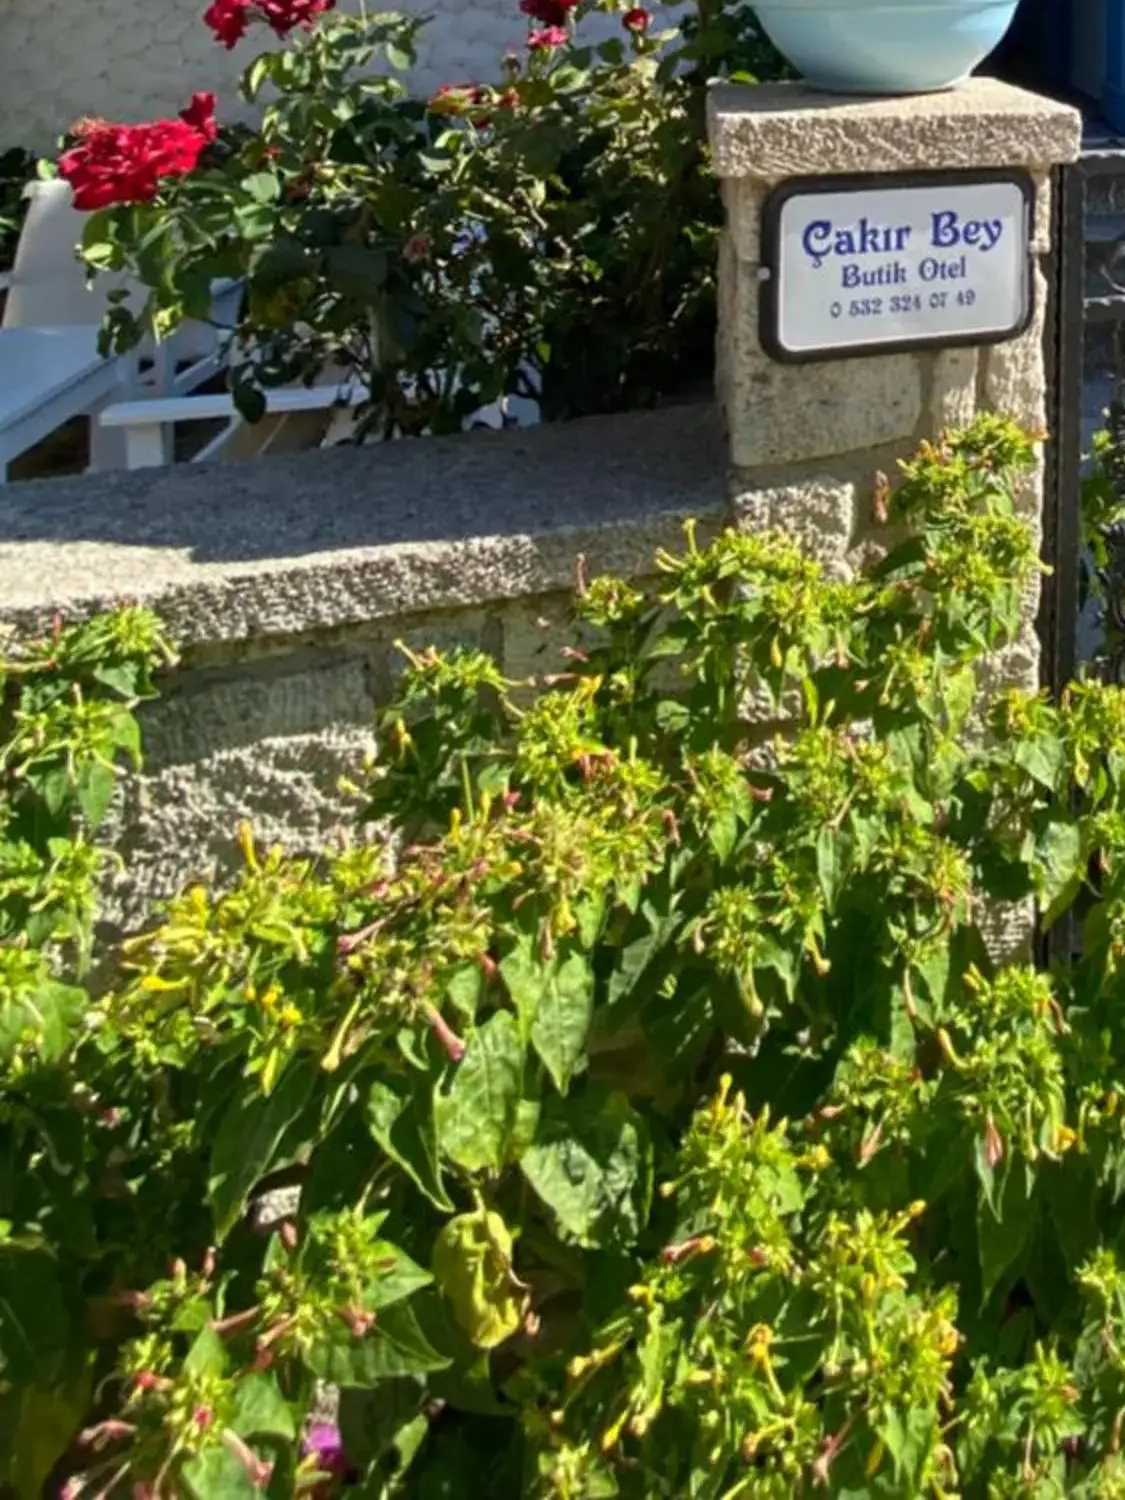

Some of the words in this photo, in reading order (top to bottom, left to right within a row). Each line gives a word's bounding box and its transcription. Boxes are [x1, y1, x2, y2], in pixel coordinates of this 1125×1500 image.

[801, 217, 912, 268] Çakır
[930, 210, 1004, 252] Bey
[841, 260, 908, 289] Butik
[918, 255, 967, 282] Otel
[829, 300, 842, 319] 0
[848, 297, 883, 317] 532
[928, 291, 950, 309] 07
